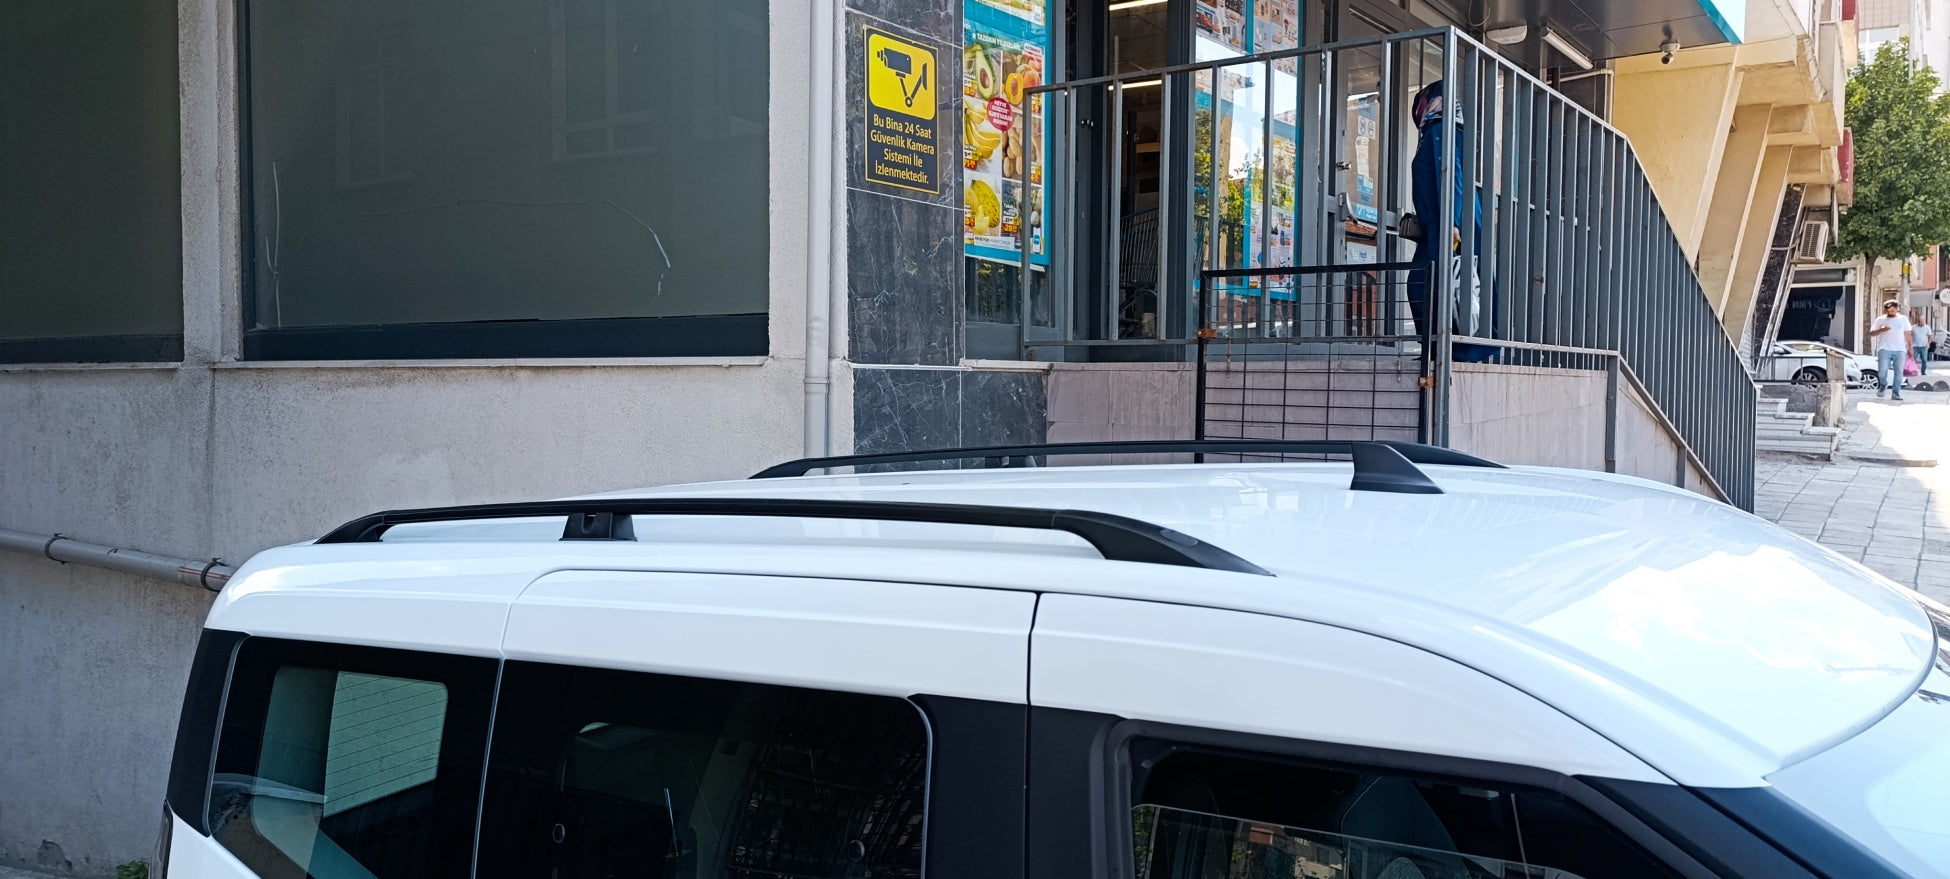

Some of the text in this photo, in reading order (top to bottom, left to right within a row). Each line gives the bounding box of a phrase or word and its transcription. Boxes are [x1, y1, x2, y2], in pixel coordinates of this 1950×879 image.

[873, 113, 932, 139] Bu Bina 24 Saat
[870, 129, 935, 155] Güvenlik Kamera
[884, 148, 912, 165] Sistemi
[875, 159, 929, 184] İzlenmektedir.
